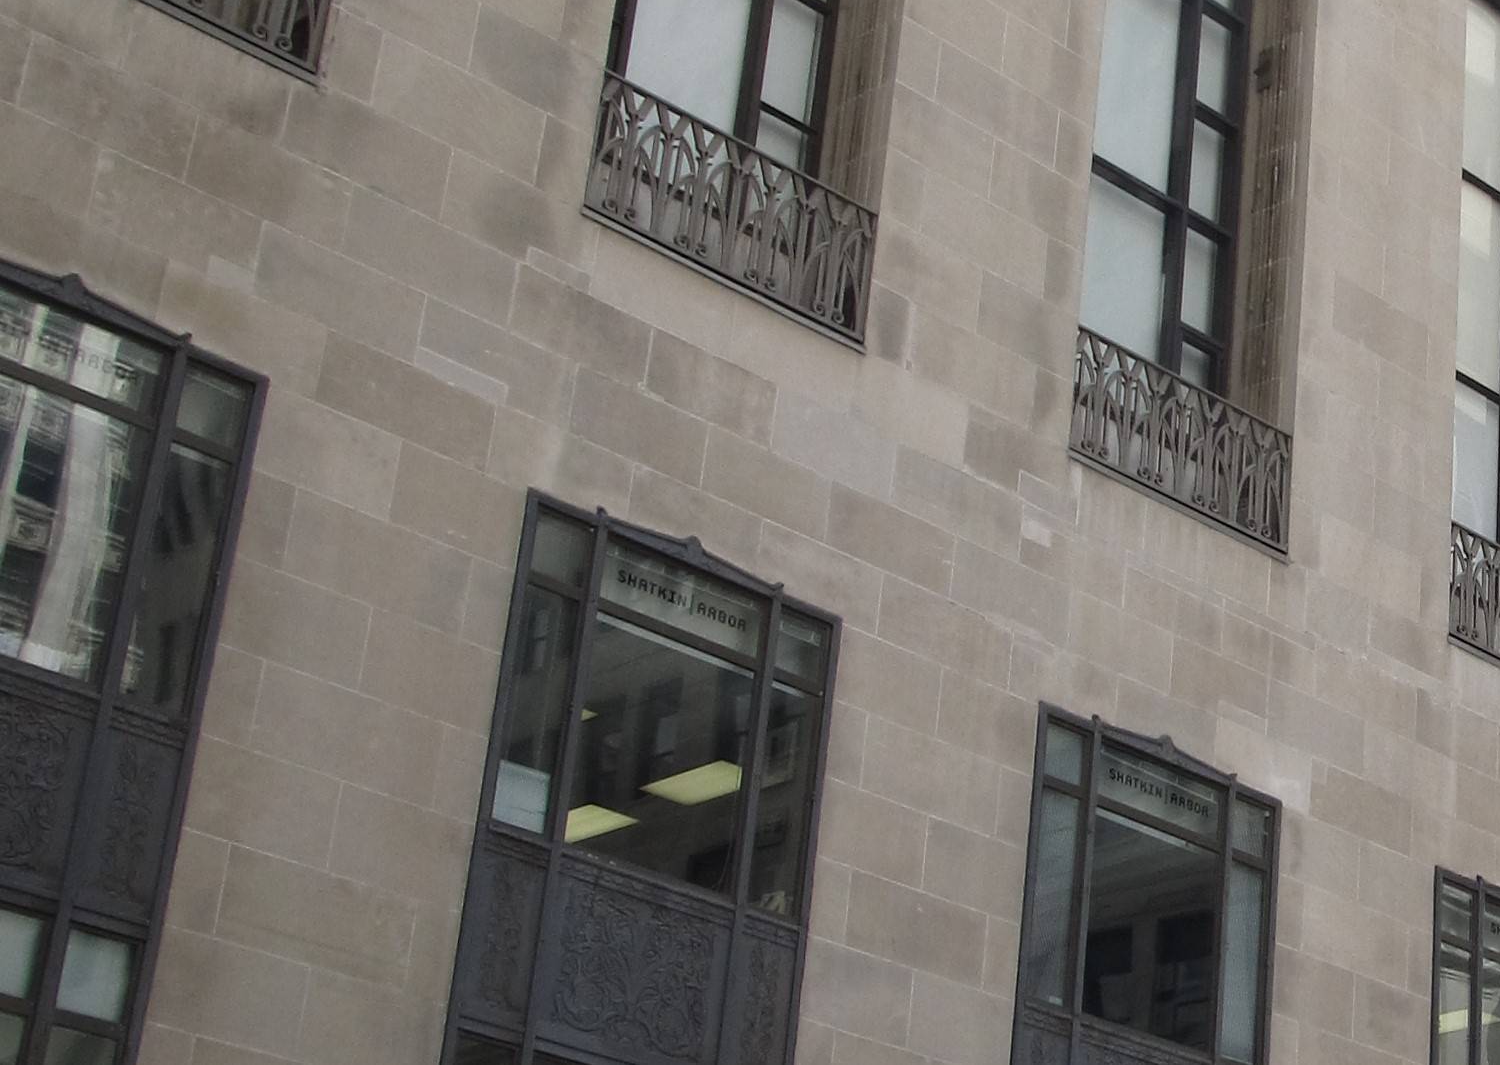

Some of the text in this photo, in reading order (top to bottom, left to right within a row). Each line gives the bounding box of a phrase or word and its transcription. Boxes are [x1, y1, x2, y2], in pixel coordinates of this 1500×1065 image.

[617, 569, 747, 631] SHATKIN ARBOR
[1108, 767, 1209, 818] SHATKIN ARBOR
